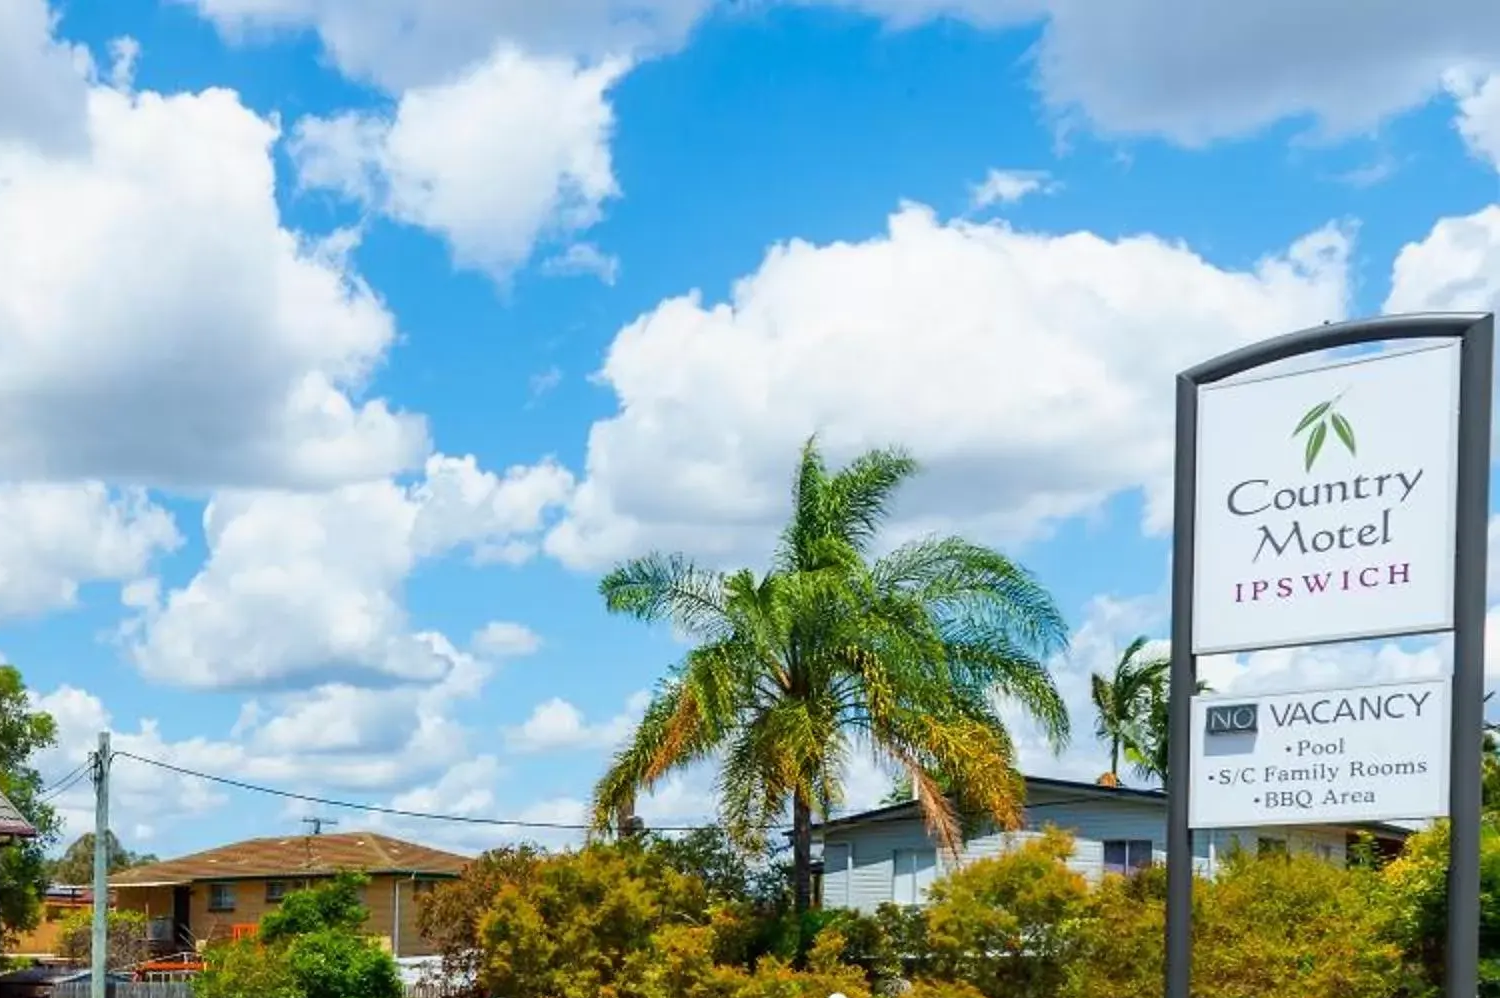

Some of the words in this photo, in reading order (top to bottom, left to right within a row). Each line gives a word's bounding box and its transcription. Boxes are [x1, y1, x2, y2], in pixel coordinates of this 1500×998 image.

[1227, 468, 1423, 516] Country
[1252, 508, 1393, 563] Motel
[1235, 562, 1410, 602] IPSWICH
[1210, 707, 1256, 729] NO
[1269, 691, 1432, 727] VACANCY
[1297, 738, 1345, 756] Pool
[1218, 767, 1256, 785] S/C
[1263, 763, 1339, 782] Family
[1349, 760, 1428, 777] Rooms
[1264, 790, 1313, 808] BBQ
[1323, 789, 1376, 805] Area
